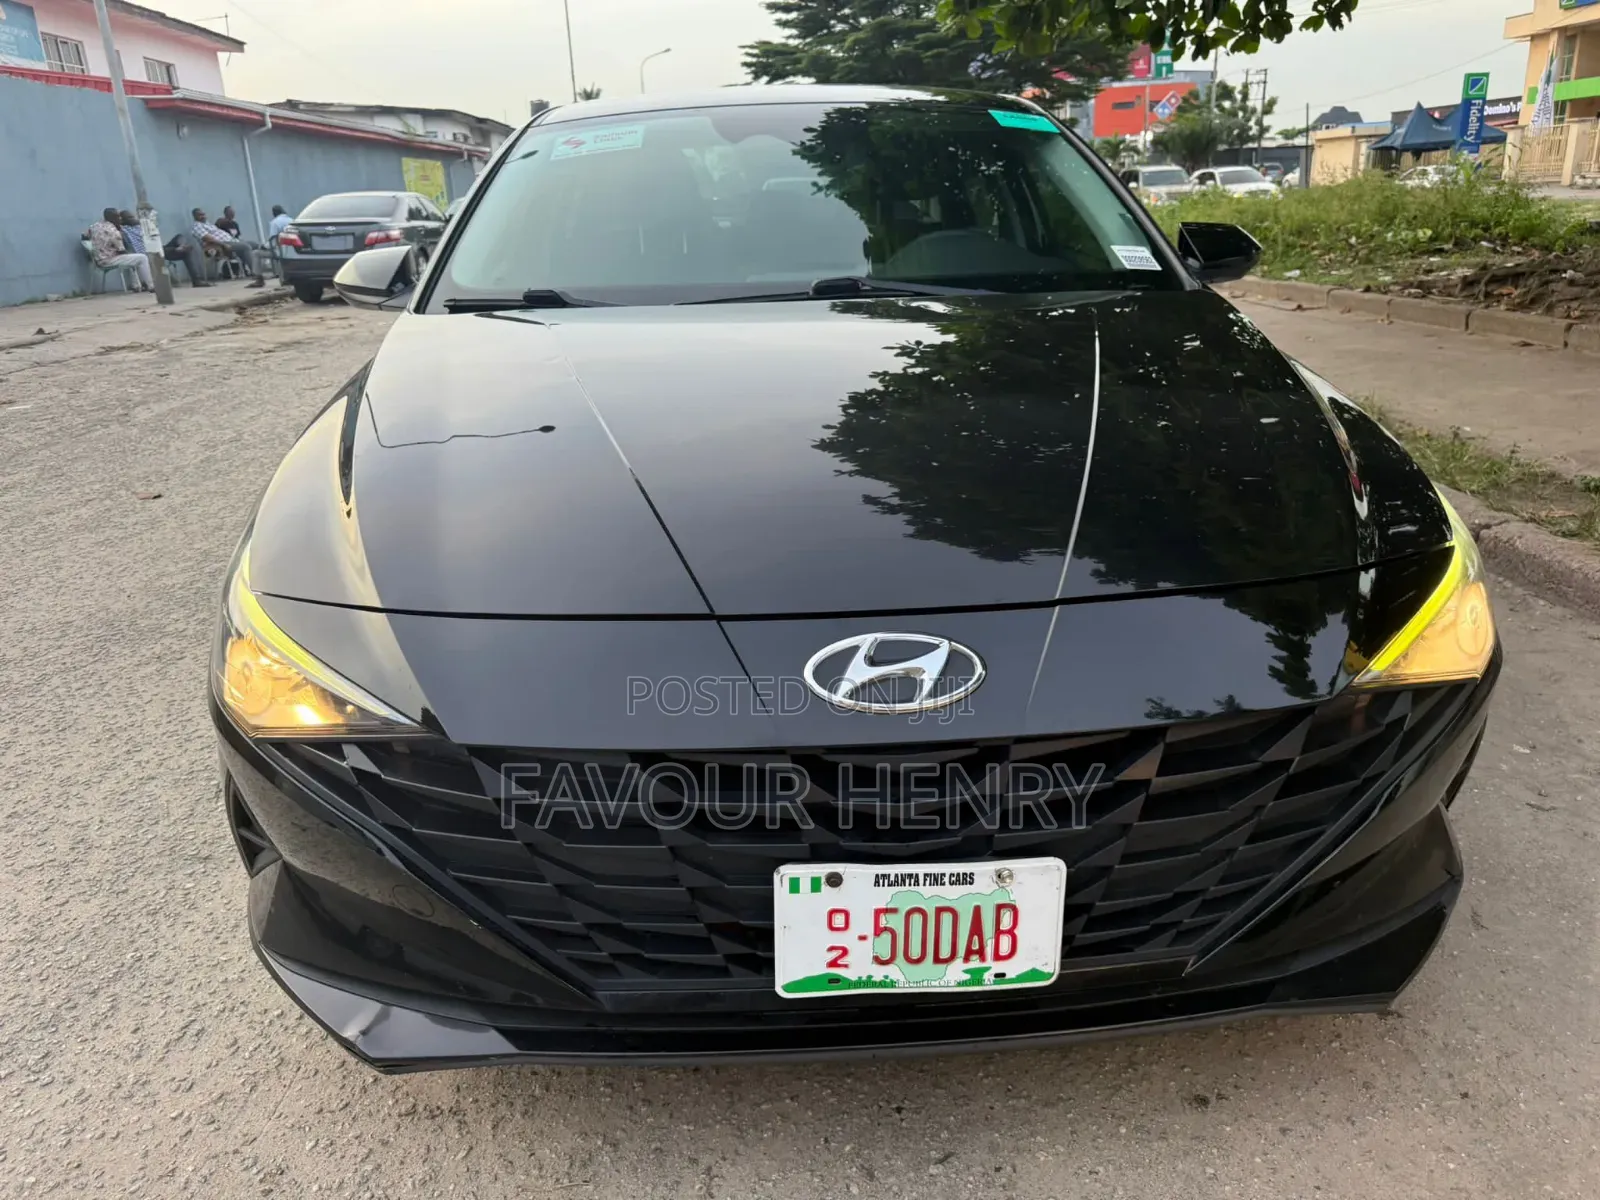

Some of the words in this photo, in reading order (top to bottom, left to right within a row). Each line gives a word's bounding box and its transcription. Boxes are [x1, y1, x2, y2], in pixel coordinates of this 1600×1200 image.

[1484, 102, 1516, 116] Domino's
[1464, 100, 1482, 143] Fidelity
[873, 873, 920, 888] ATLANTA
[922, 872, 946, 887] FINE
[948, 872, 975, 886] CARS
[848, 980, 888, 989] FEDERAL
[891, 979, 937, 988] REPUBLIC
[938, 979, 952, 988] OF
[954, 977, 993, 987] NIGERIA
